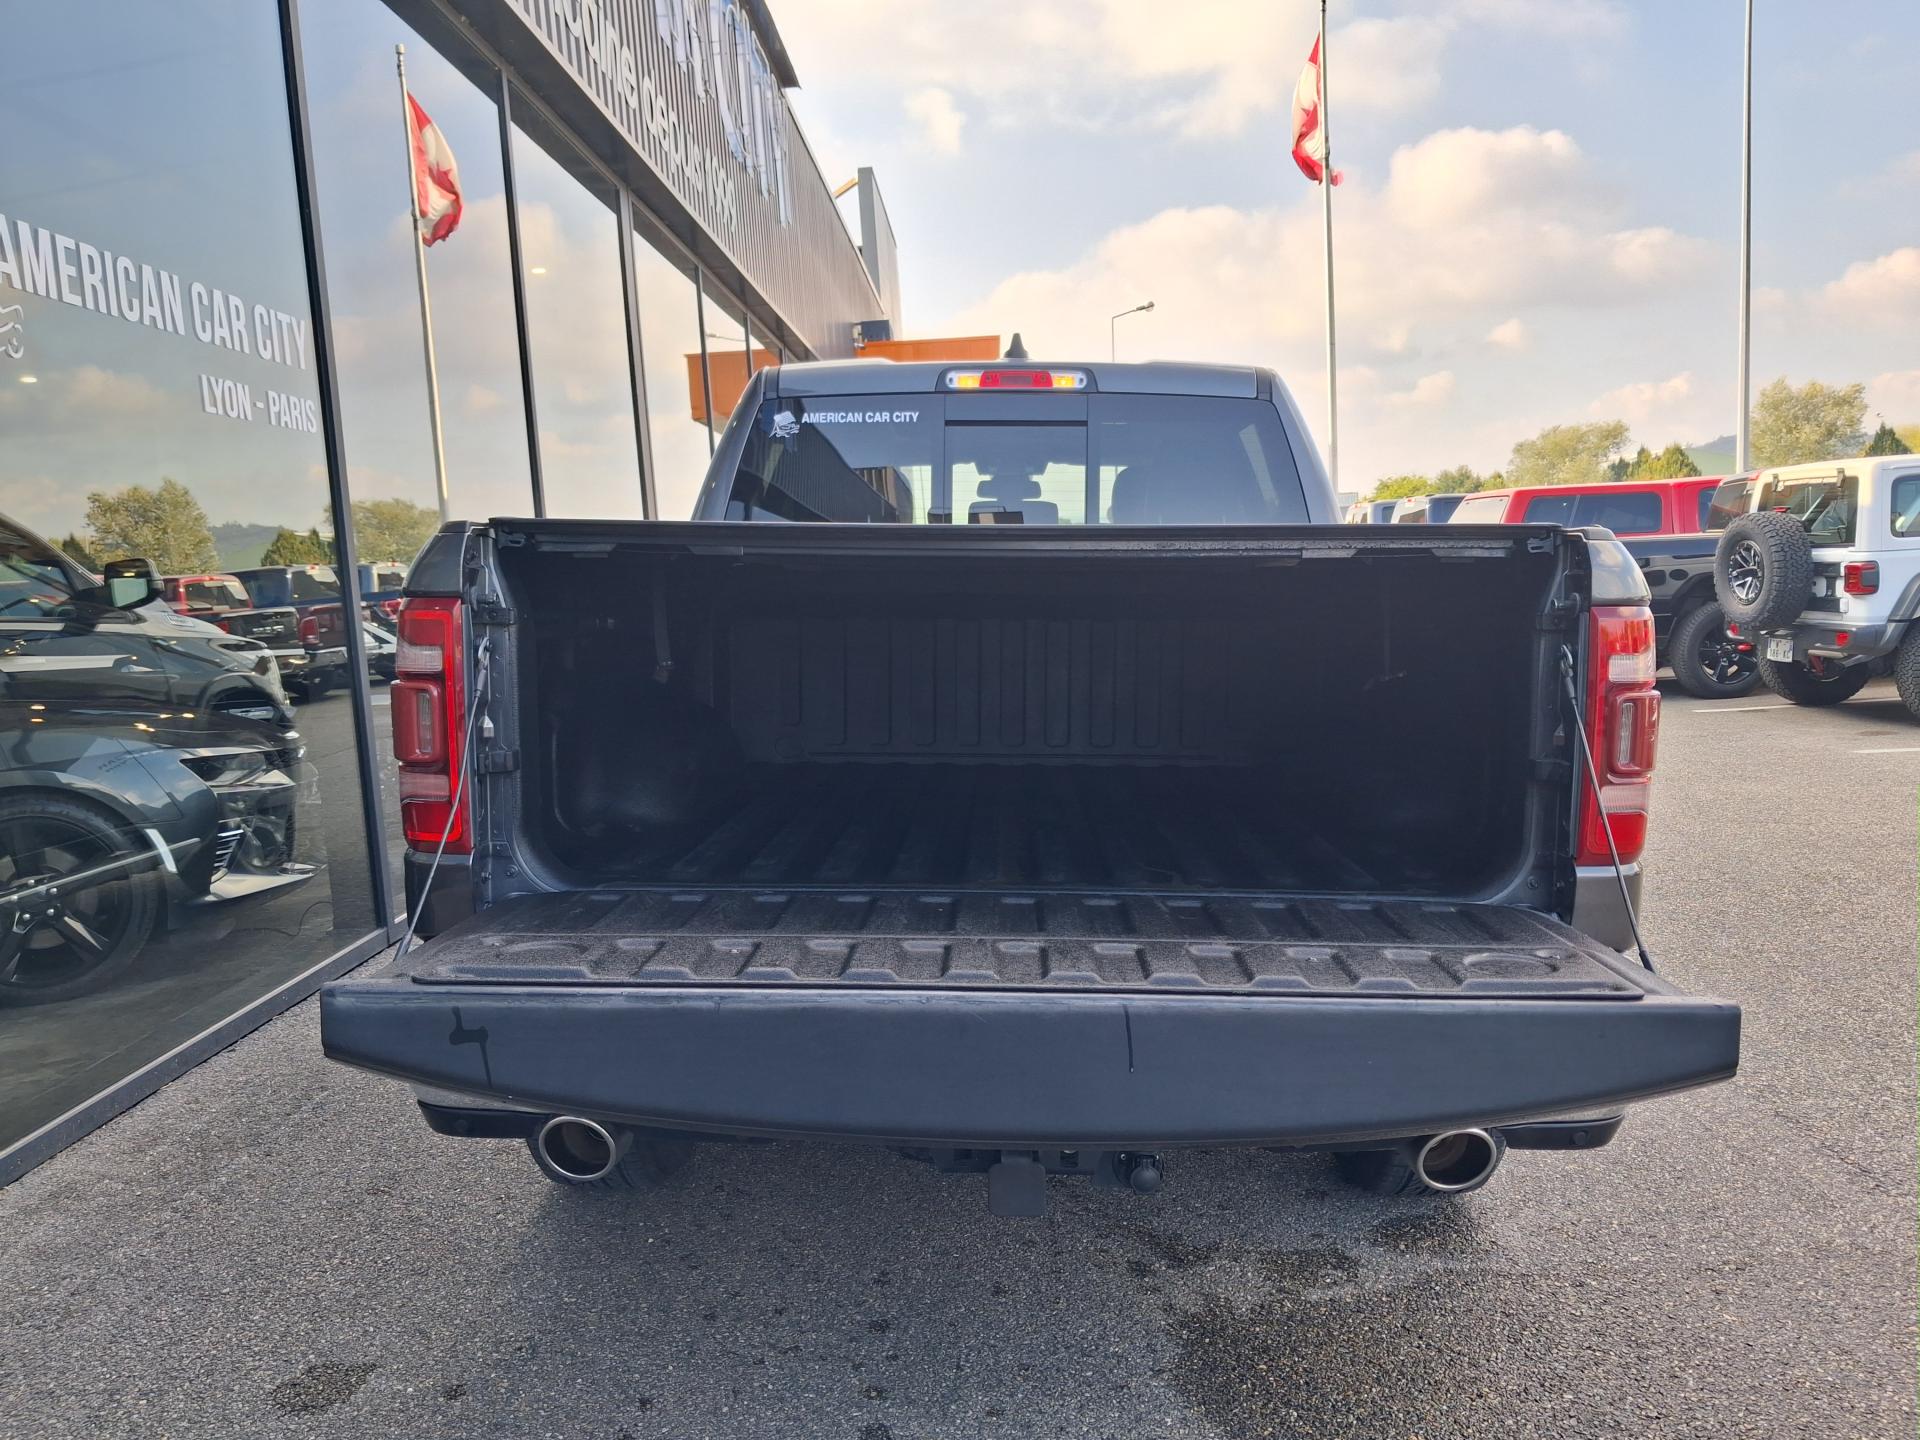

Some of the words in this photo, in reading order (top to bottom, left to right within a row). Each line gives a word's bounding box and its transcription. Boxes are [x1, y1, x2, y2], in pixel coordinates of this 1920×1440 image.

[642, 68, 703, 193] depuis
[0, 213, 185, 336] AMERICAN
[190, 282, 250, 354] CAR
[252, 304, 307, 370] CITY
[200, 374, 252, 421] LYON
[265, 390, 318, 434] PARIS
[801, 411, 863, 424] AMERICAN
[865, 411, 891, 423] CAR
[892, 411, 920, 423] CITY
